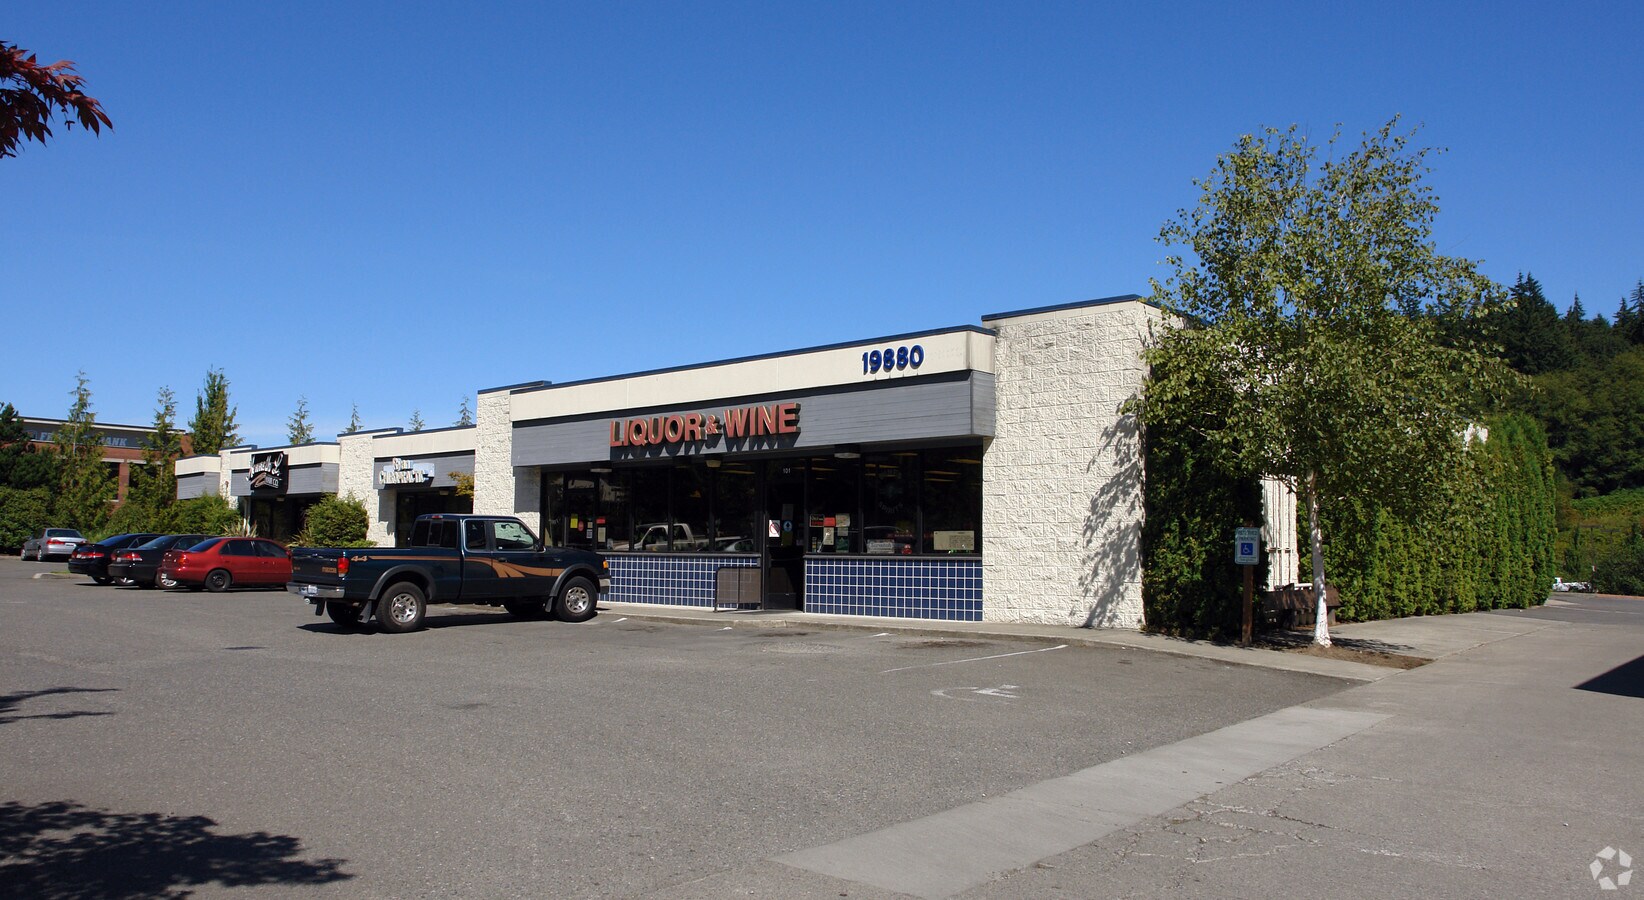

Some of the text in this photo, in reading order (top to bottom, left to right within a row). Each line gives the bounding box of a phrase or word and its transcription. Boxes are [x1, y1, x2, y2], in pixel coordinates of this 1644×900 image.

[862, 345, 925, 375] 19880
[609, 402, 802, 447] LIQUOR & WINE
